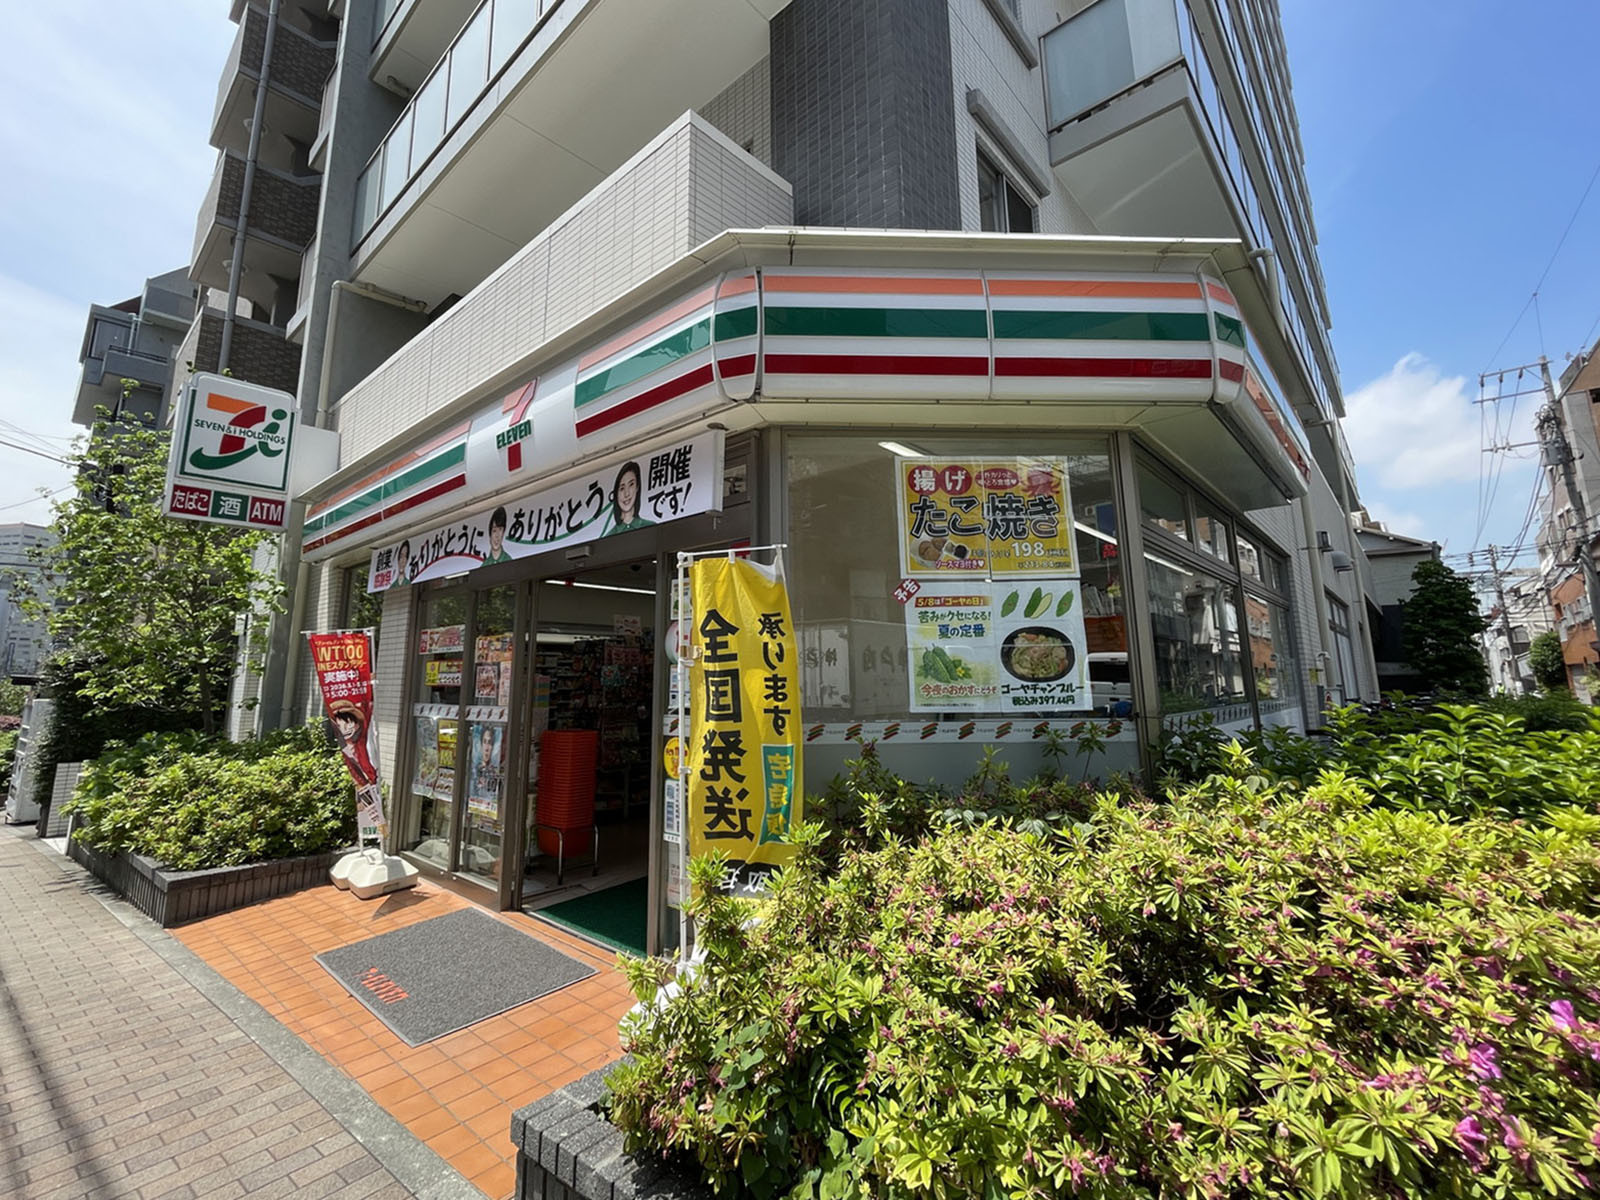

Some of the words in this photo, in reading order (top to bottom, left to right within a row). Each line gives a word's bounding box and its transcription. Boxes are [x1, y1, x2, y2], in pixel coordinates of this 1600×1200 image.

[239, 429, 286, 445] HOLDINGS
[648, 444, 692, 490] 開催
[913, 469, 967, 491] 揚げ
[172, 489, 208, 512] たばこ
[218, 495, 242, 516] 酒
[251, 501, 283, 522] ATM
[910, 493, 1060, 541] たこ焼き
[894, 577, 919, 602] 予告
[938, 624, 985, 639] 夏の定番
